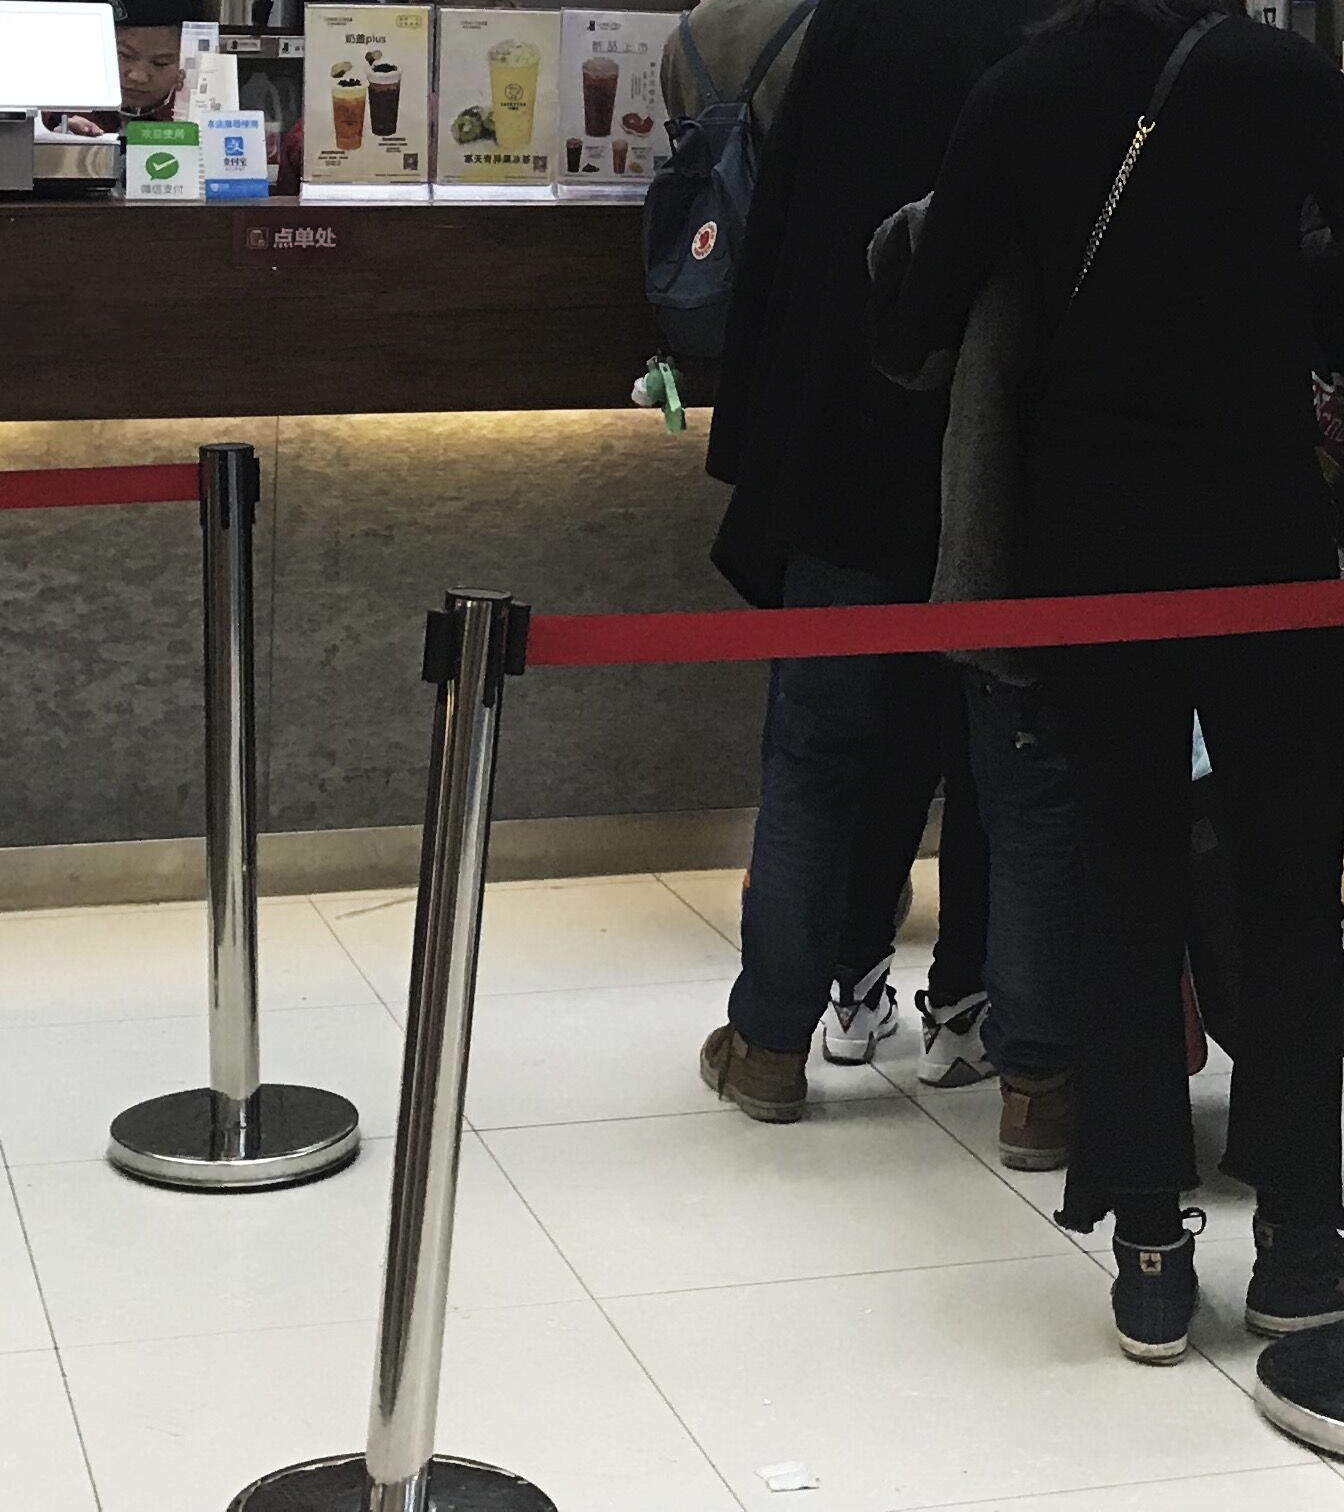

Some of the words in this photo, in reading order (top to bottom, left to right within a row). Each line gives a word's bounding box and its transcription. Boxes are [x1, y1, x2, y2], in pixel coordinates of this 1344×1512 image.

[345, 34, 387, 45] 奶盖plus
[140, 183, 184, 195] 微信支付
[273, 227, 337, 248] 点单处
